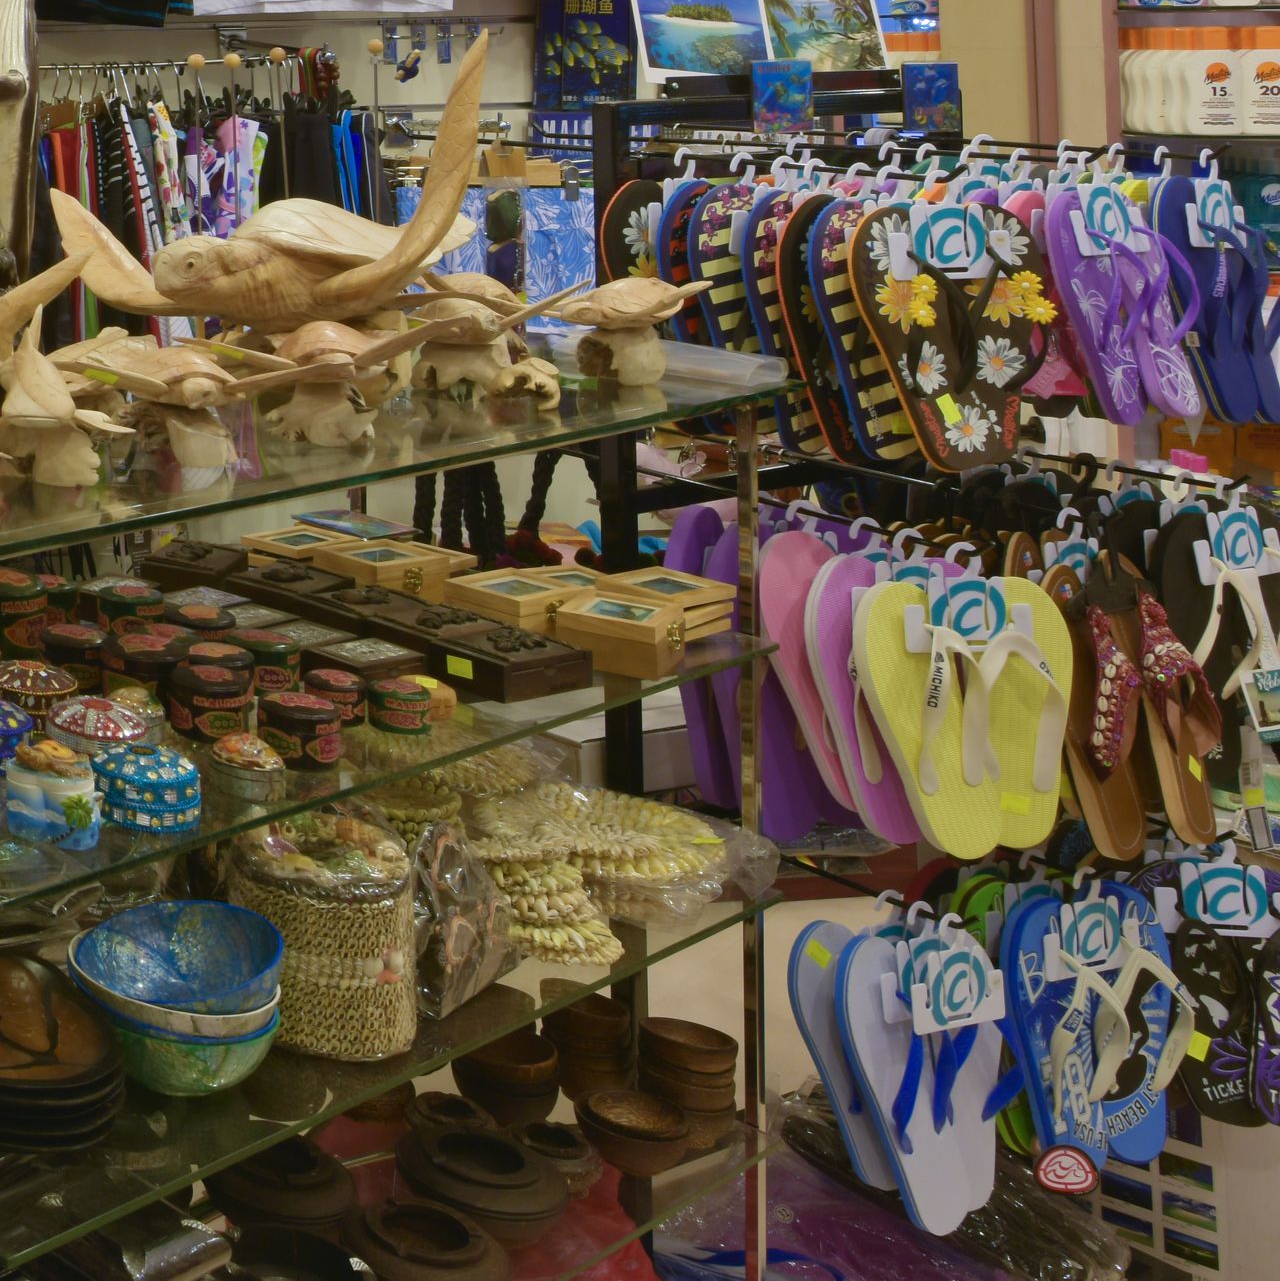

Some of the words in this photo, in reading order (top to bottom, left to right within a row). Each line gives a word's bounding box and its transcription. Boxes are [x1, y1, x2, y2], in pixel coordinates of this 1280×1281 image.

[1210, 86, 1228, 97] 15
[1258, 85, 1280, 96] 20
[927, 664, 944, 709] MICHIKO
[1106, 1103, 1147, 1138] BEACH
[1072, 1121, 1094, 1149] USA
